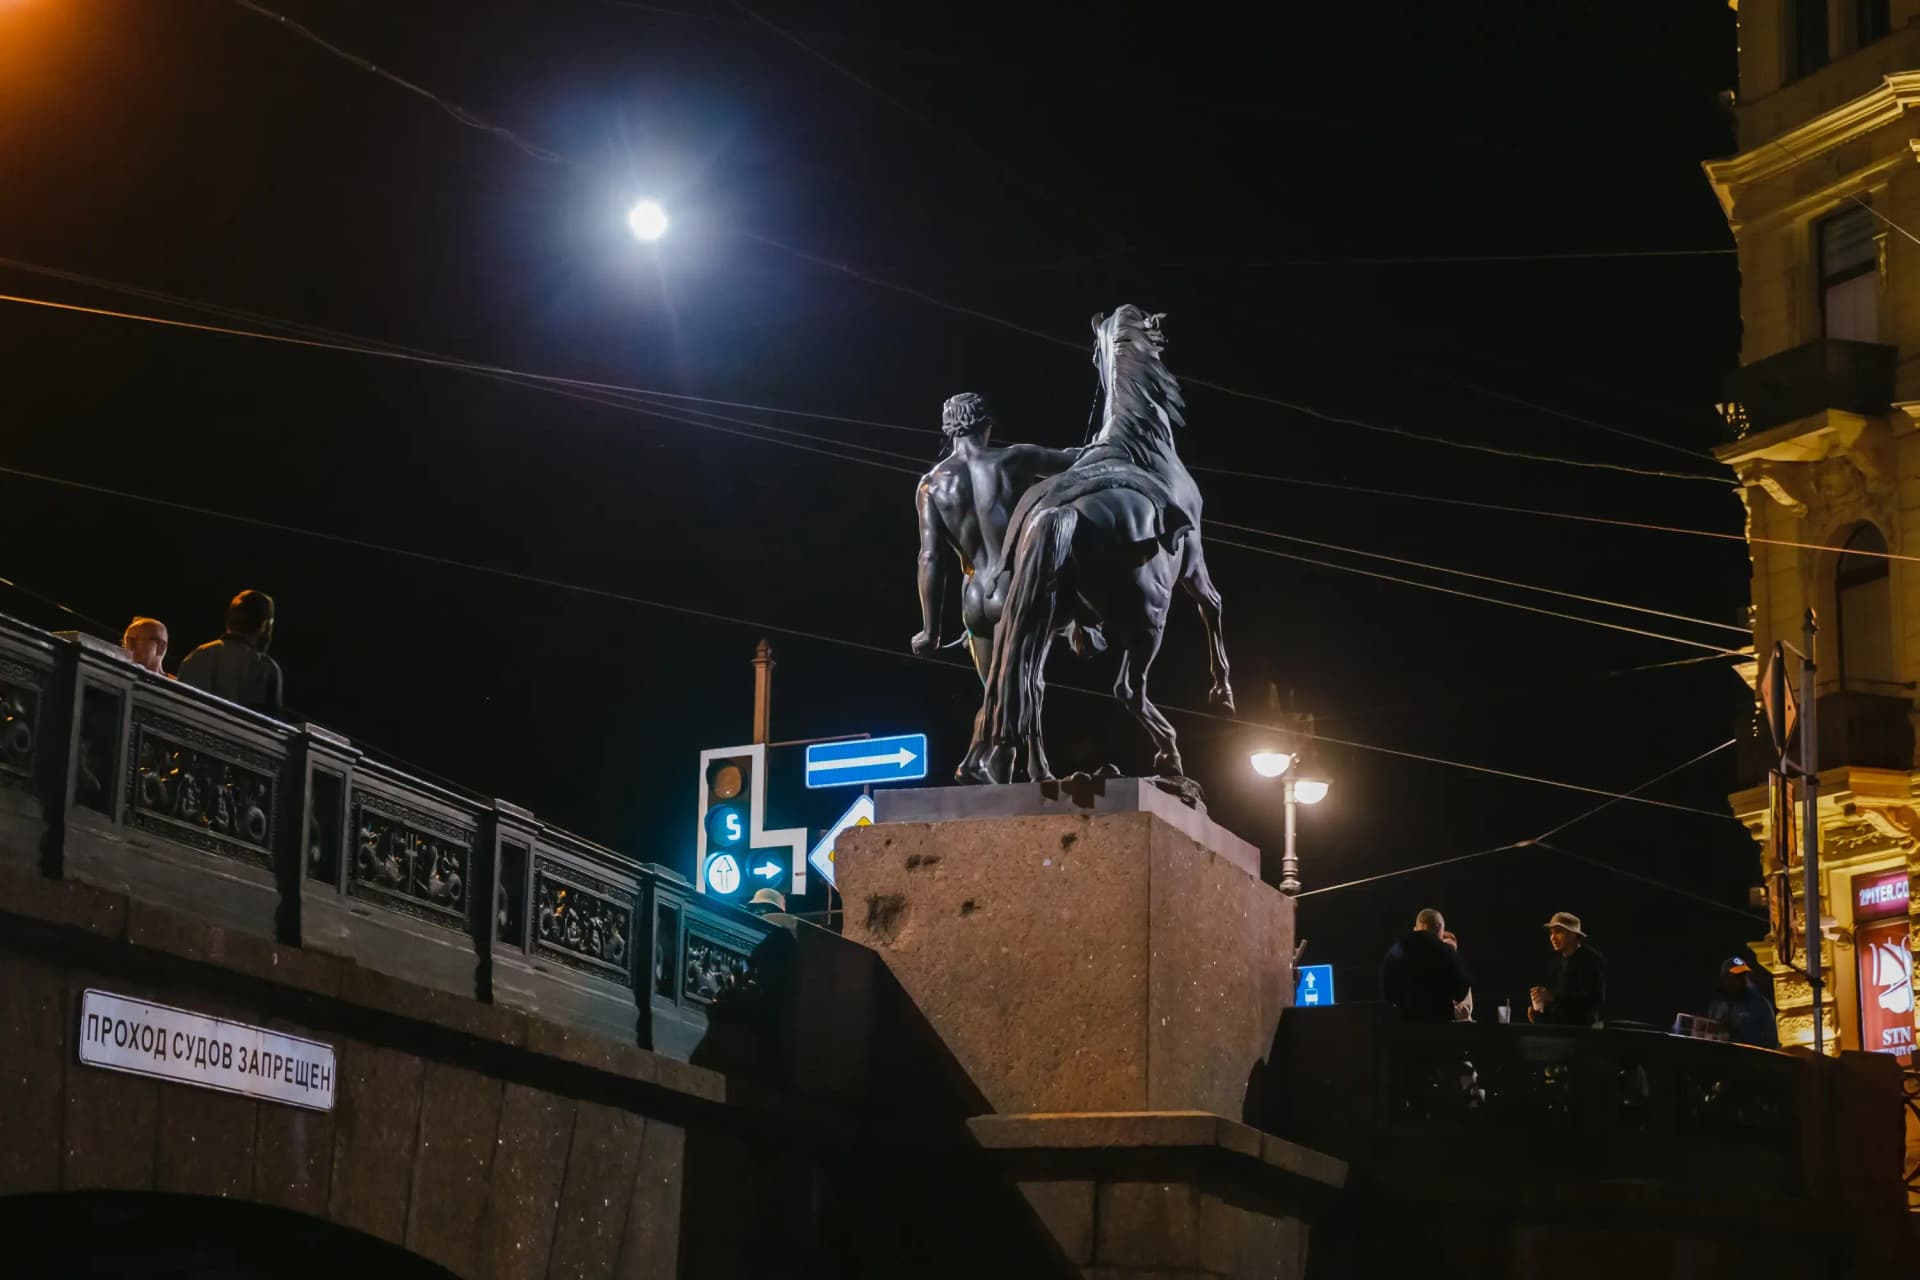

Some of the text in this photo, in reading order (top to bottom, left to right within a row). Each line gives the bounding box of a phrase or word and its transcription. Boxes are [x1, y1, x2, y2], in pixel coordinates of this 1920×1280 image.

[87, 1013, 331, 1092] ПРОХОД СУДОВ ЗАПРЕЩЕН
